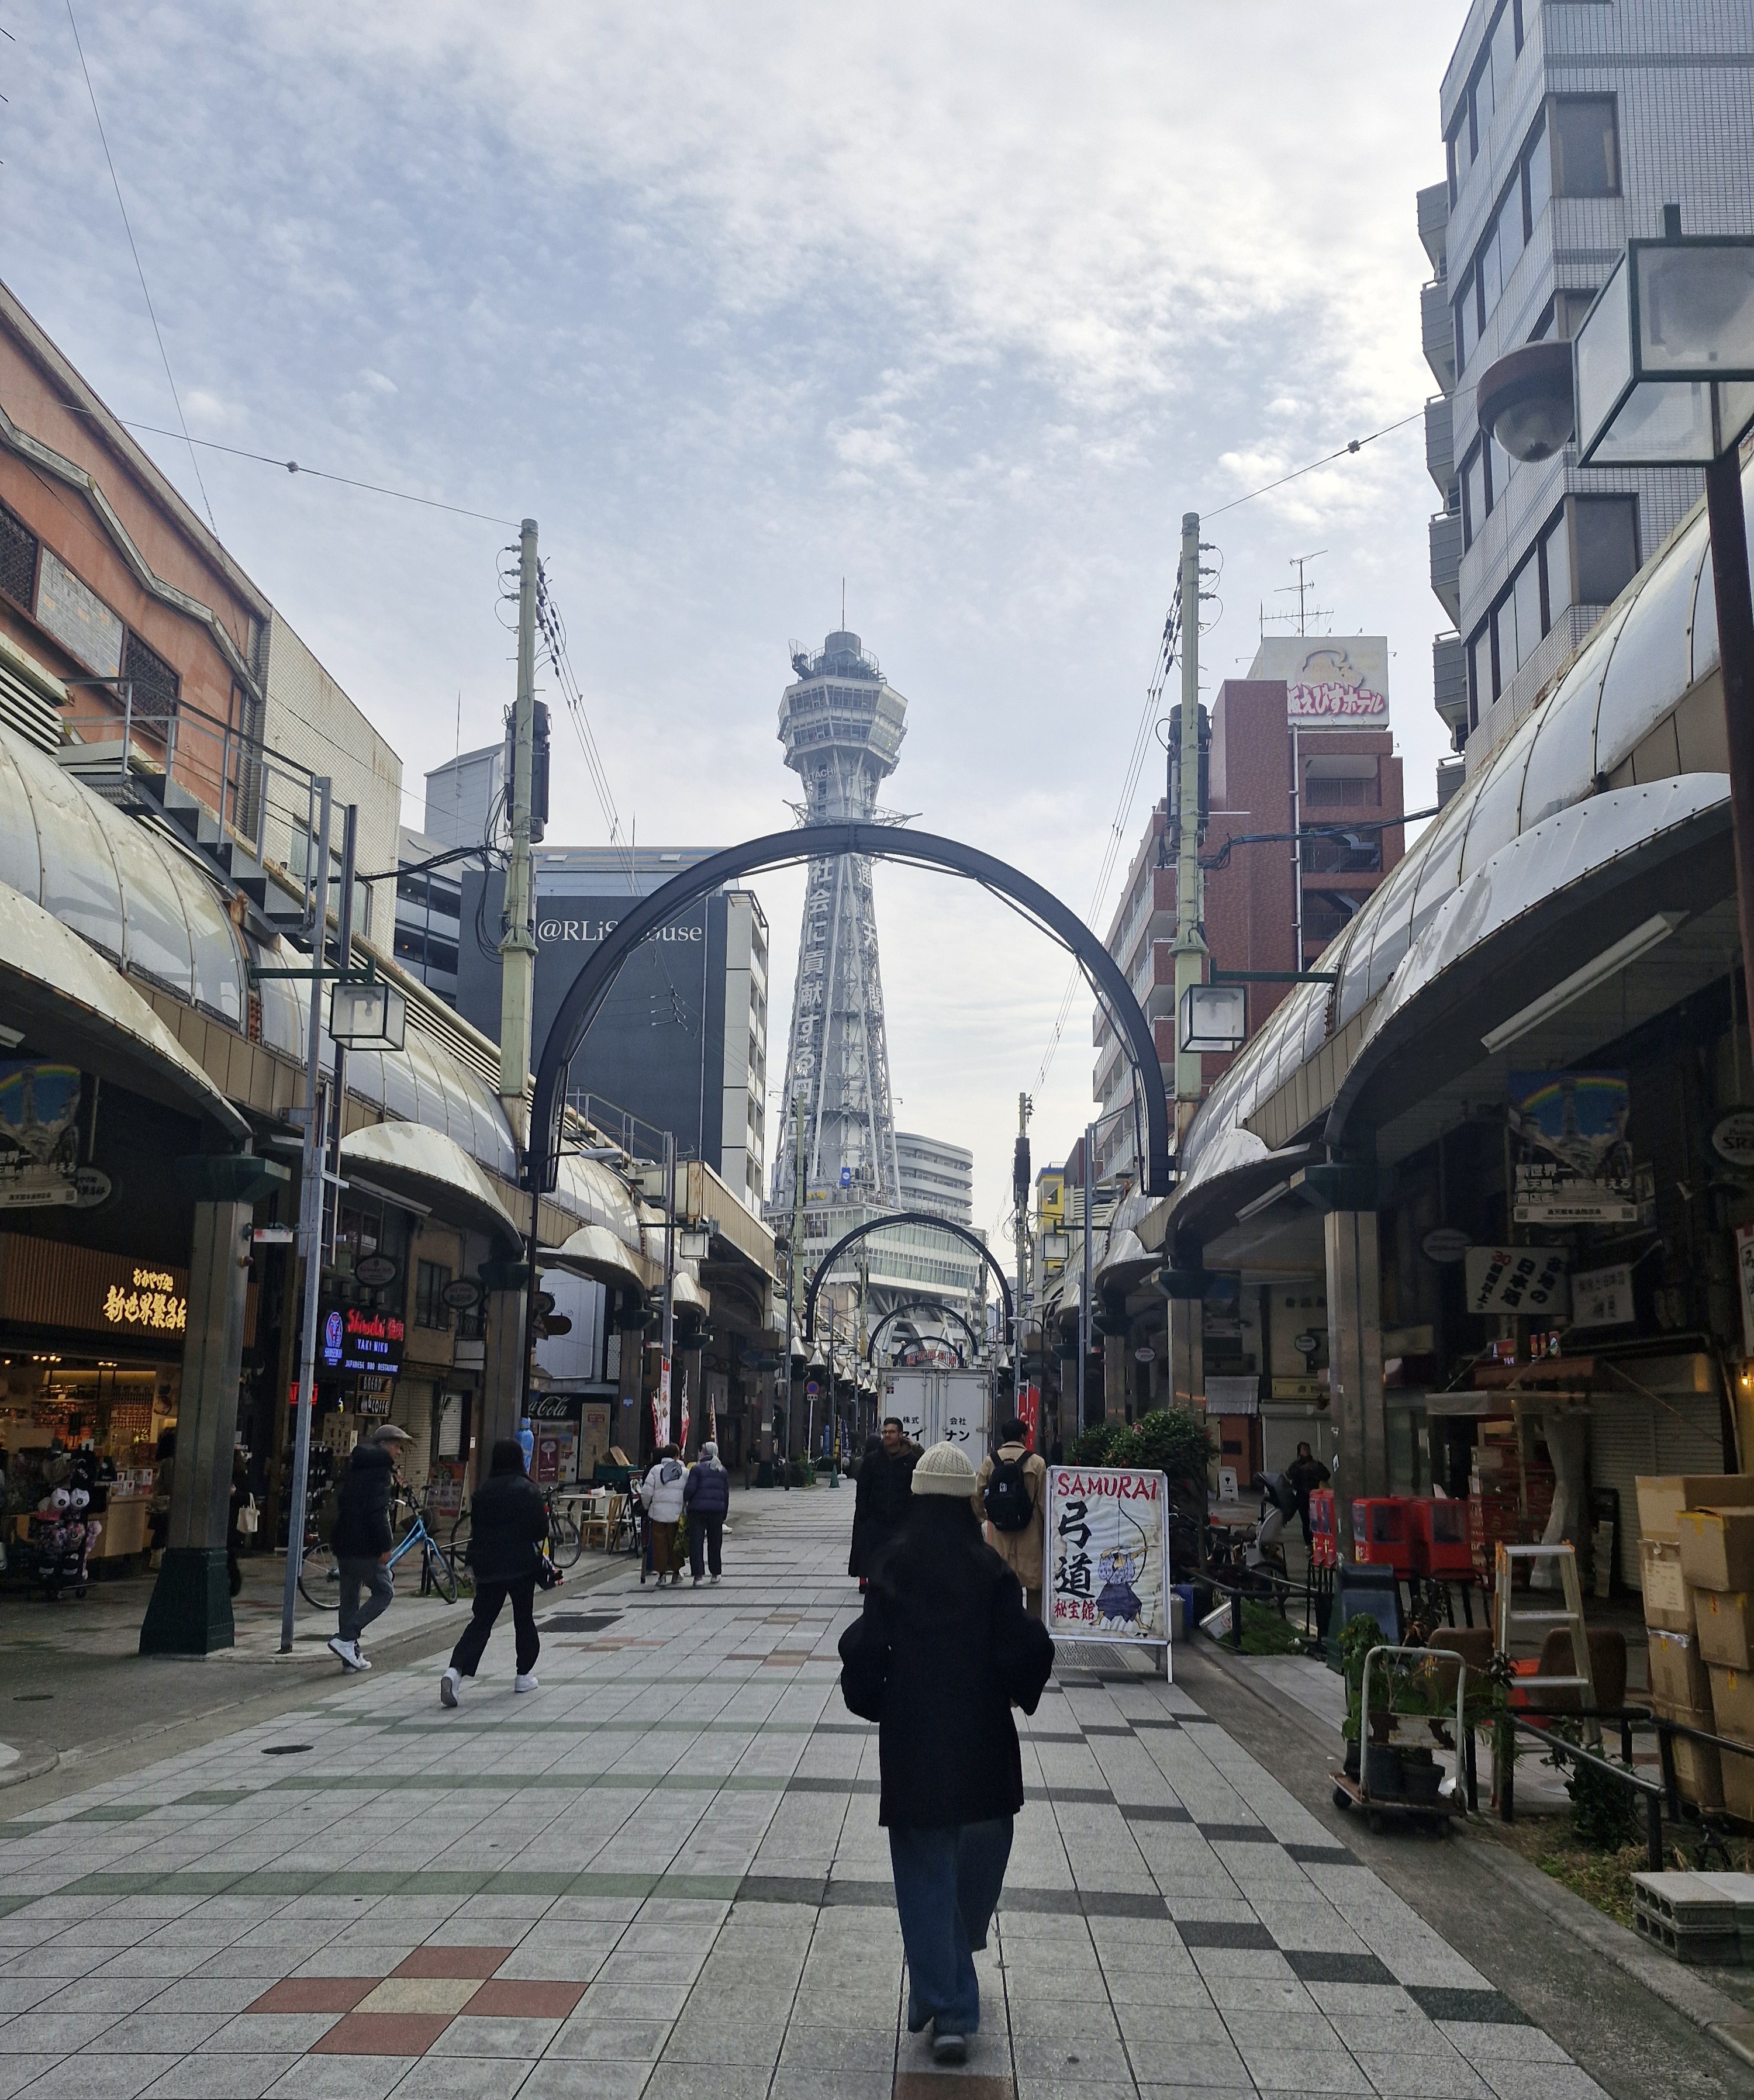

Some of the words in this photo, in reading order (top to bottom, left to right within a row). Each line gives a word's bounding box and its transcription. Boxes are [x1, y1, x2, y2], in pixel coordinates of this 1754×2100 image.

[803, 767, 836, 781] ITACHI
[357, 1338, 372, 1351] YAKI
[374, 1341, 388, 1353] NIKU
[345, 1359, 365, 1369] JAPANESE
[364, 1376, 382, 1391] BREAD
[529, 1396, 570, 1416] a-Cola
[903, 1417, 919, 1425] 株式
[949, 1417, 967, 1425] 会社
[1058, 1473, 1157, 1500] SAMURAI
[1055, 1501, 1096, 1598] 弓道
[1054, 1598, 1096, 1621] 秘宝館
